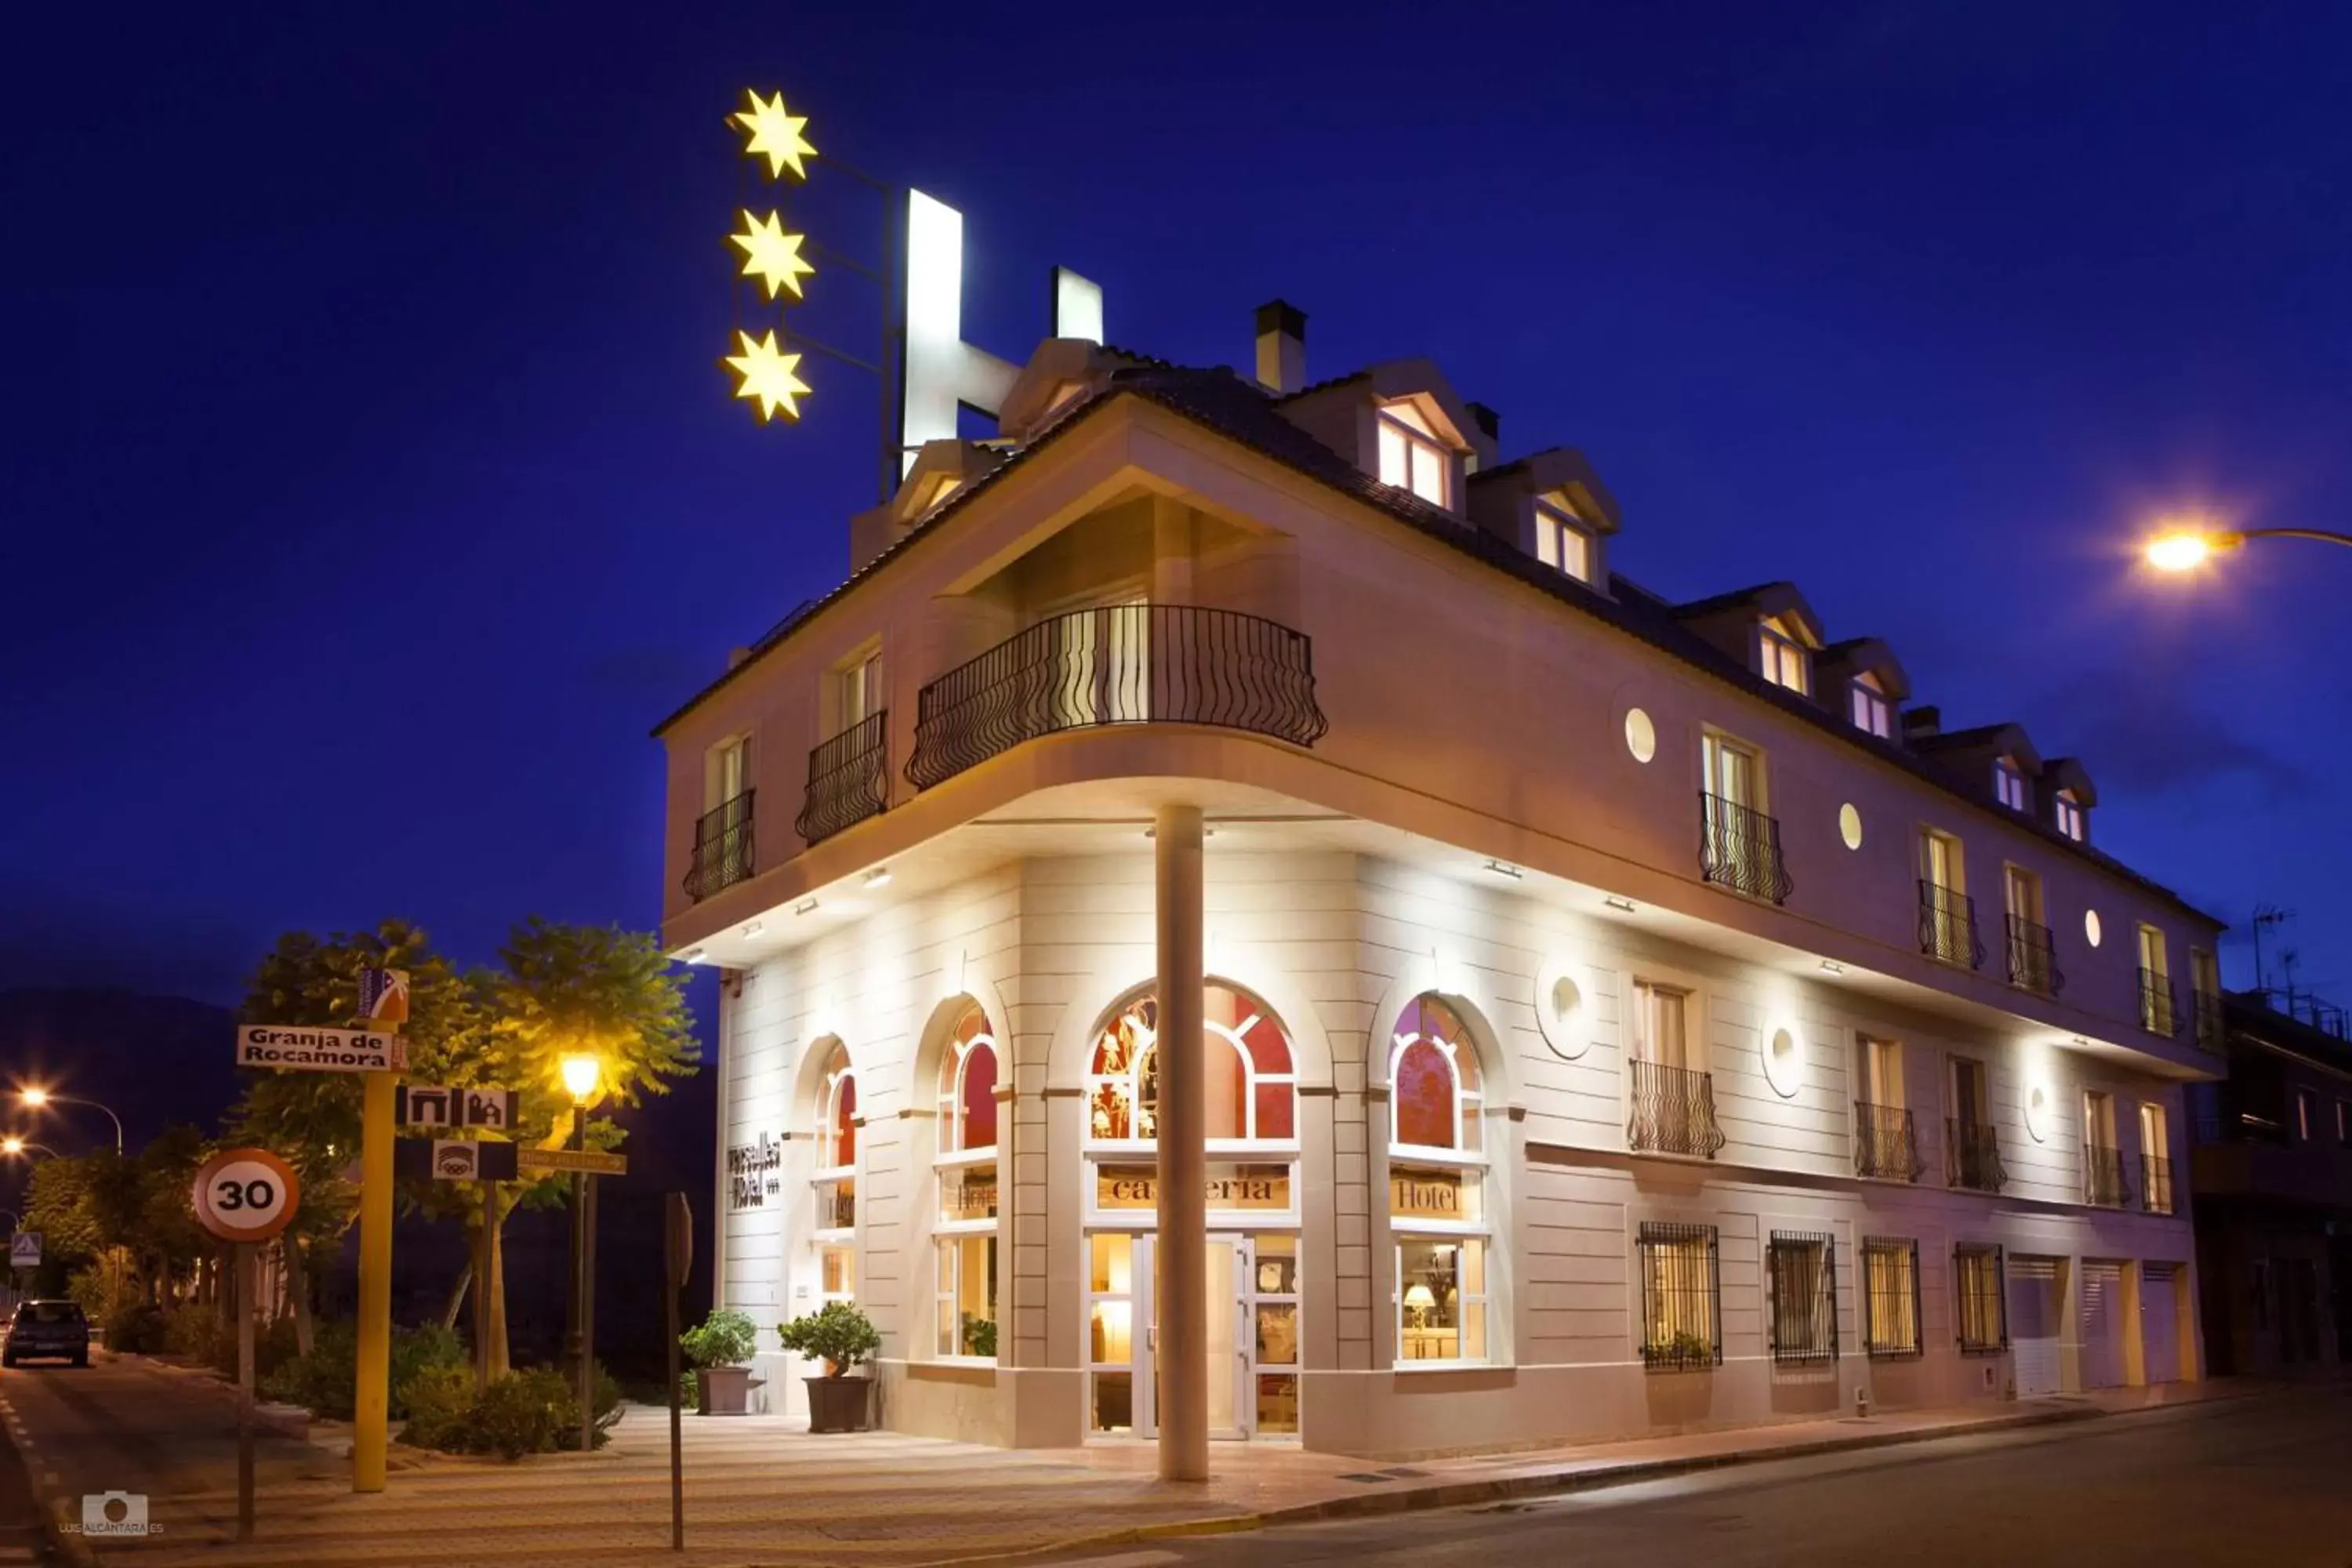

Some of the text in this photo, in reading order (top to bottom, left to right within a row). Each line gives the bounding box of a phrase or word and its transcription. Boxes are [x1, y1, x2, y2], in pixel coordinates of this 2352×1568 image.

[248, 1028, 383, 1051] Granja de
[245, 1046, 387, 1067] Rocamora
[216, 1180, 274, 1211] 30
[1112, 1178, 1273, 1202] caeria
[1398, 1179, 1457, 1211] Hotel
